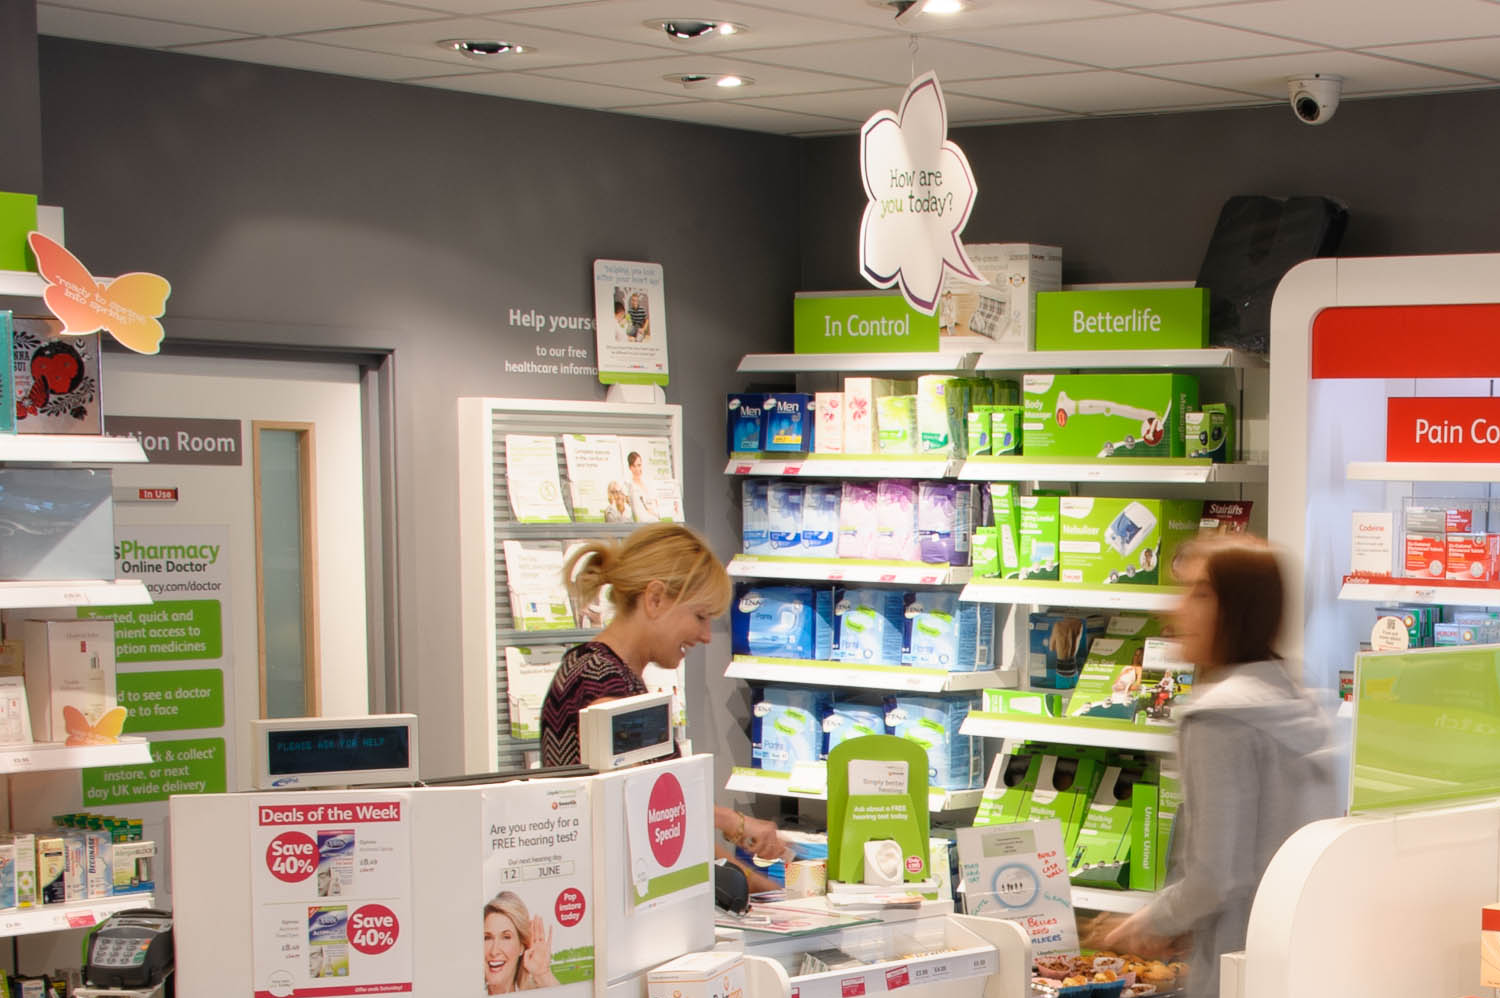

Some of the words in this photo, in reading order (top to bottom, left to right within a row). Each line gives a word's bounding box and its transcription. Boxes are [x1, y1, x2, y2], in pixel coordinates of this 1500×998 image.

[890, 169, 915, 188] How
[919, 169, 942, 186] are
[881, 195, 903, 219] you
[909, 191, 953, 217] today?
[509, 309, 545, 332] Help
[550, 312, 598, 332] yours
[825, 316, 842, 336] In
[847, 314, 909, 337] Control
[1073, 309, 1161, 333] Betterlife
[536, 345, 546, 355] to
[549, 347, 565, 357] our
[568, 346, 587, 358] free
[505, 360, 558, 373] healthcare
[777, 401, 799, 413] Men
[1415, 419, 1463, 444] Pain
[178, 431, 236, 452] Room
[144, 490, 154, 498] In
[156, 490, 172, 499] Use
[1209, 504, 1243, 516] Stairlifts
[113, 540, 219, 564] sPharmacy
[122, 561, 162, 574] Online
[166, 561, 208, 573] Doctor
[139, 611, 168, 623] quick
[172, 610, 194, 622] and
[149, 628, 185, 637] access
[150, 641, 206, 653] medicines
[143, 691, 162, 701] see
[175, 688, 211, 699] doctor
[154, 703, 178, 716] face
[164, 766, 190, 776] next
[88, 785, 109, 799] day
[112, 785, 129, 796] UK
[133, 782, 159, 794] wide
[163, 779, 206, 793] delivery
[261, 808, 304, 823] Deals
[308, 807, 322, 821] of
[328, 807, 352, 820] the
[356, 805, 398, 819] Week
[649, 802, 686, 823] Manager's
[490, 824, 506, 835] Are
[509, 823, 526, 835] you
[529, 820, 555, 833] ready
[558, 817, 571, 828] for
[492, 838, 515, 849] FREE
[519, 834, 554, 849] hearing
[557, 831, 578, 844] test?
[655, 825, 680, 844] Special
[272, 841, 313, 855] Save
[273, 857, 313, 873] 40%
[539, 866, 560, 877] JUNE
[563, 893, 577, 903] Pop
[559, 902, 582, 911] instore
[561, 912, 579, 922] today
